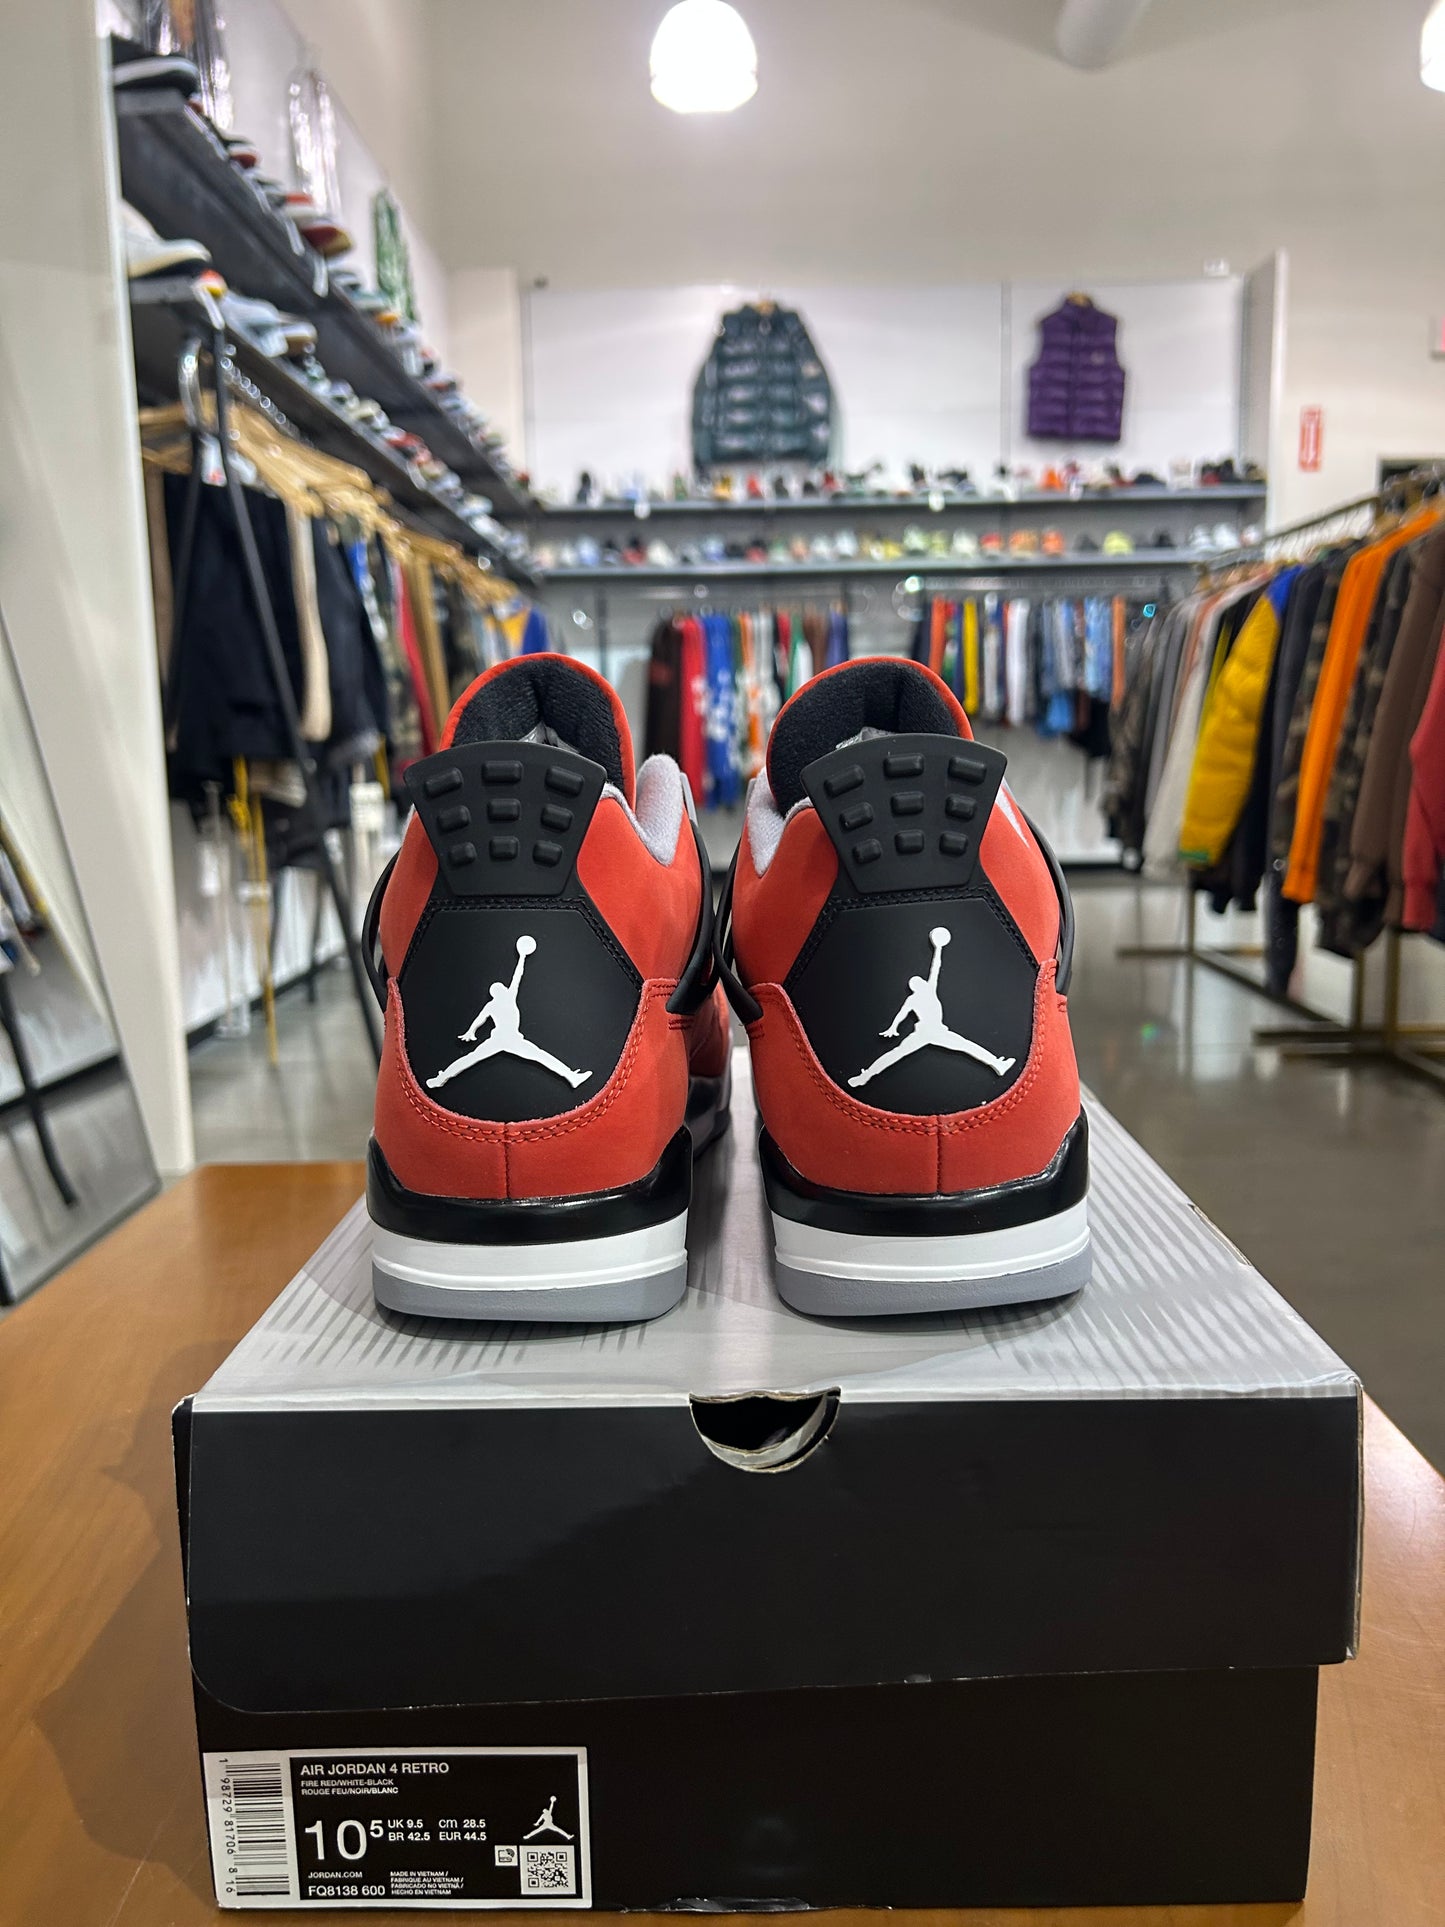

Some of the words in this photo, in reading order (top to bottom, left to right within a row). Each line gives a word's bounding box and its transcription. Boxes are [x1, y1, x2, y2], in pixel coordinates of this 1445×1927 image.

[300, 1764, 325, 1776] AIR
[327, 1763, 386, 1775] JORDAN
[389, 1763, 399, 1774] 4
[401, 1762, 450, 1774] RETRO
[300, 1779, 319, 1787] FIRE
[320, 1778, 394, 1787] RED/WHITE-BLACK
[220, 1777, 233, 1813] 98729
[301, 1788, 330, 1796] ROUGE
[331, 1786, 399, 1795] FEU/NOIR/BLANC
[387, 1819, 404, 1829] UK
[406, 1819, 424, 1829] 9.5
[438, 1819, 458, 1829] cm
[462, 1818, 486, 1829] 28.5
[224, 1820, 236, 1855] 81706
[388, 1831, 405, 1841] BR
[407, 1831, 431, 1841] 42.5
[438, 1831, 462, 1841] EUR
[463, 1831, 487, 1841] 44.5
[308, 1871, 363, 1879] JORDAN.COM
[308, 1885, 359, 1897] FQ8138
[361, 1885, 386, 1896] 600
